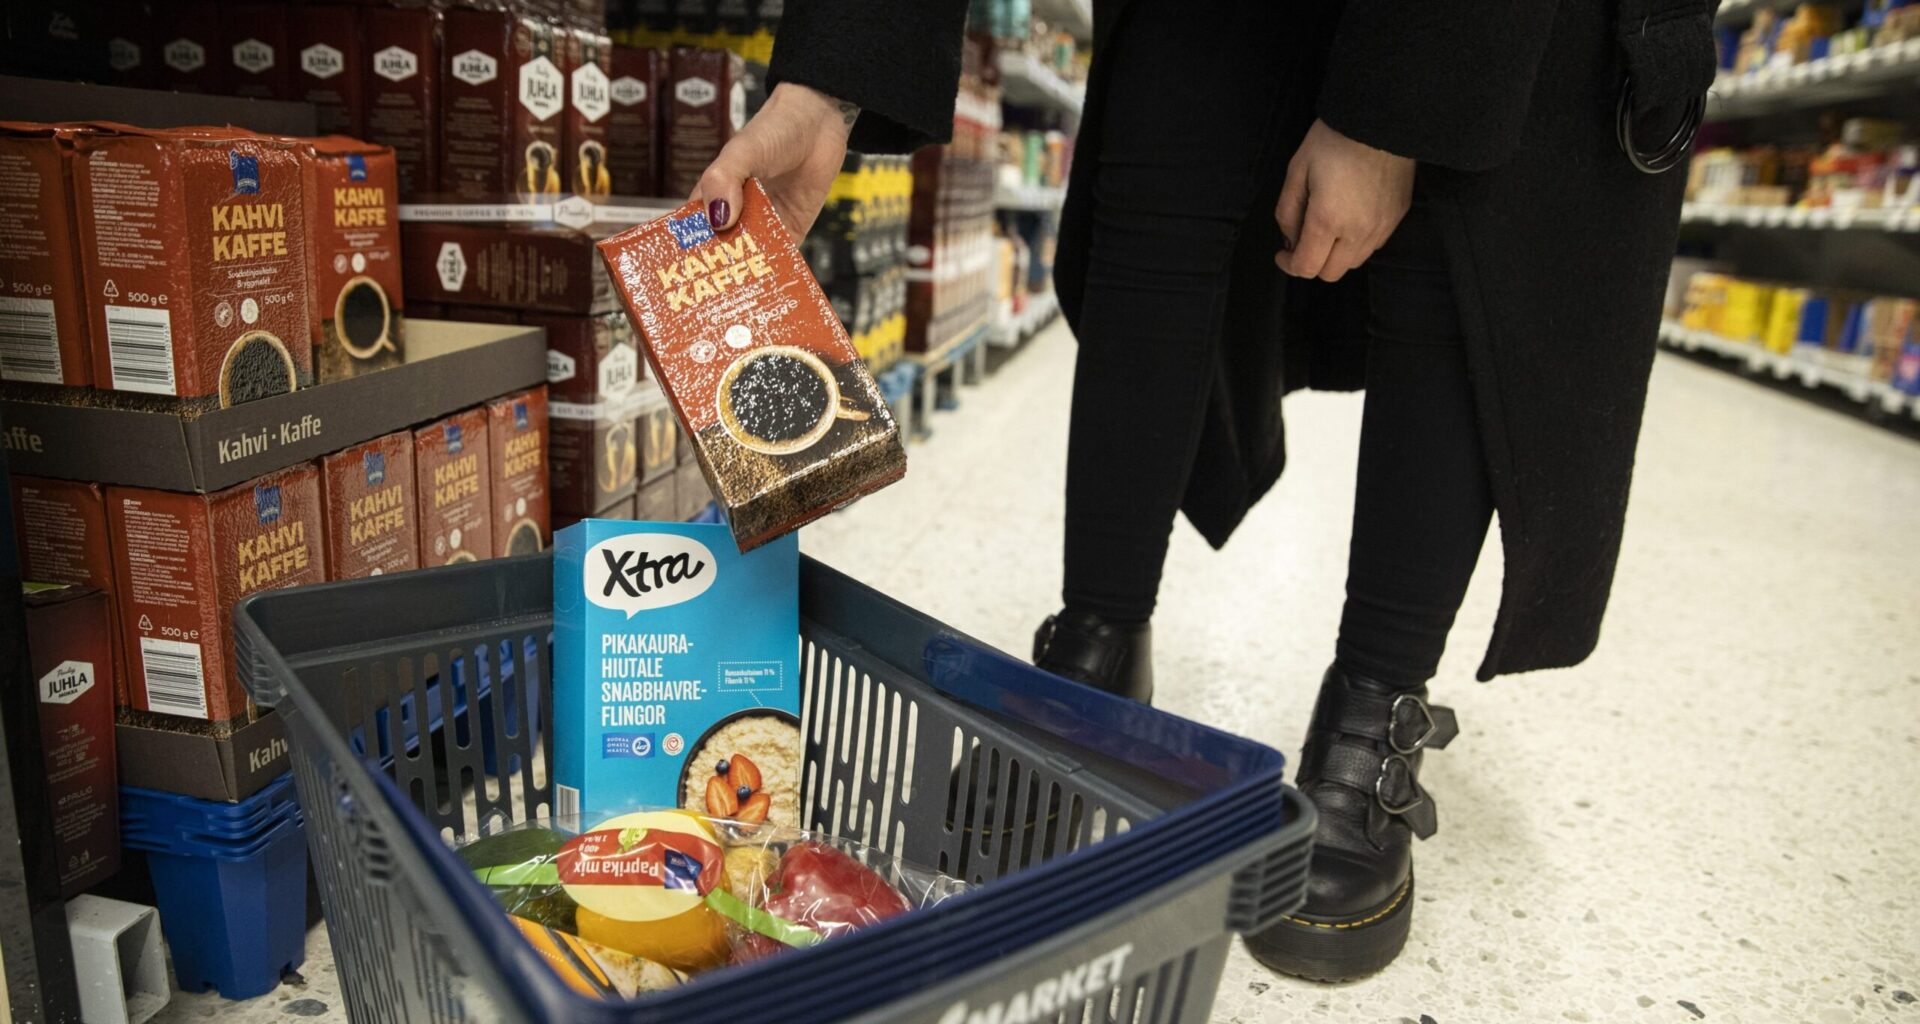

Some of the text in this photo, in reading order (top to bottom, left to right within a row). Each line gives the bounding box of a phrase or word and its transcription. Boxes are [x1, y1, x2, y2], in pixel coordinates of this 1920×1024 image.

[527, 77, 557, 100] JUHLA
[334, 187, 384, 206] KAHVI
[211, 203, 284, 232] KAHVI
[334, 207, 386, 227] KAFFE
[212, 231, 288, 262] KAFFE
[656, 231, 758, 290] KAHVI
[128, 291, 149, 303] 500
[666, 253, 773, 313] KAFFE
[264, 293, 281, 305] 500
[218, 414, 321, 464] Kahvi Kaffe
[505, 429, 540, 458] KAHVI
[435, 454, 477, 486] KAHVI
[504, 448, 541, 478] KAFFE
[350, 484, 402, 521] KAHVI
[435, 473, 479, 508] KAFFE
[351, 506, 405, 546] KAFFE
[238, 520, 304, 565] KAHVI
[239, 544, 308, 593] KAFFE
[601, 548, 705, 598] Xtra
[161, 626, 181, 637] 500
[602, 633, 694, 655] PIKAKAURA-
[602, 657, 664, 678] HIUTALE
[48, 672, 88, 699] JUHLA
[601, 680, 708, 702] SNABBHAVRE-
[601, 704, 665, 727] FLINGOR
[249, 738, 288, 773] Kahv
[573, 859, 599, 877] mix
[602, 857, 660, 877] Paprika
